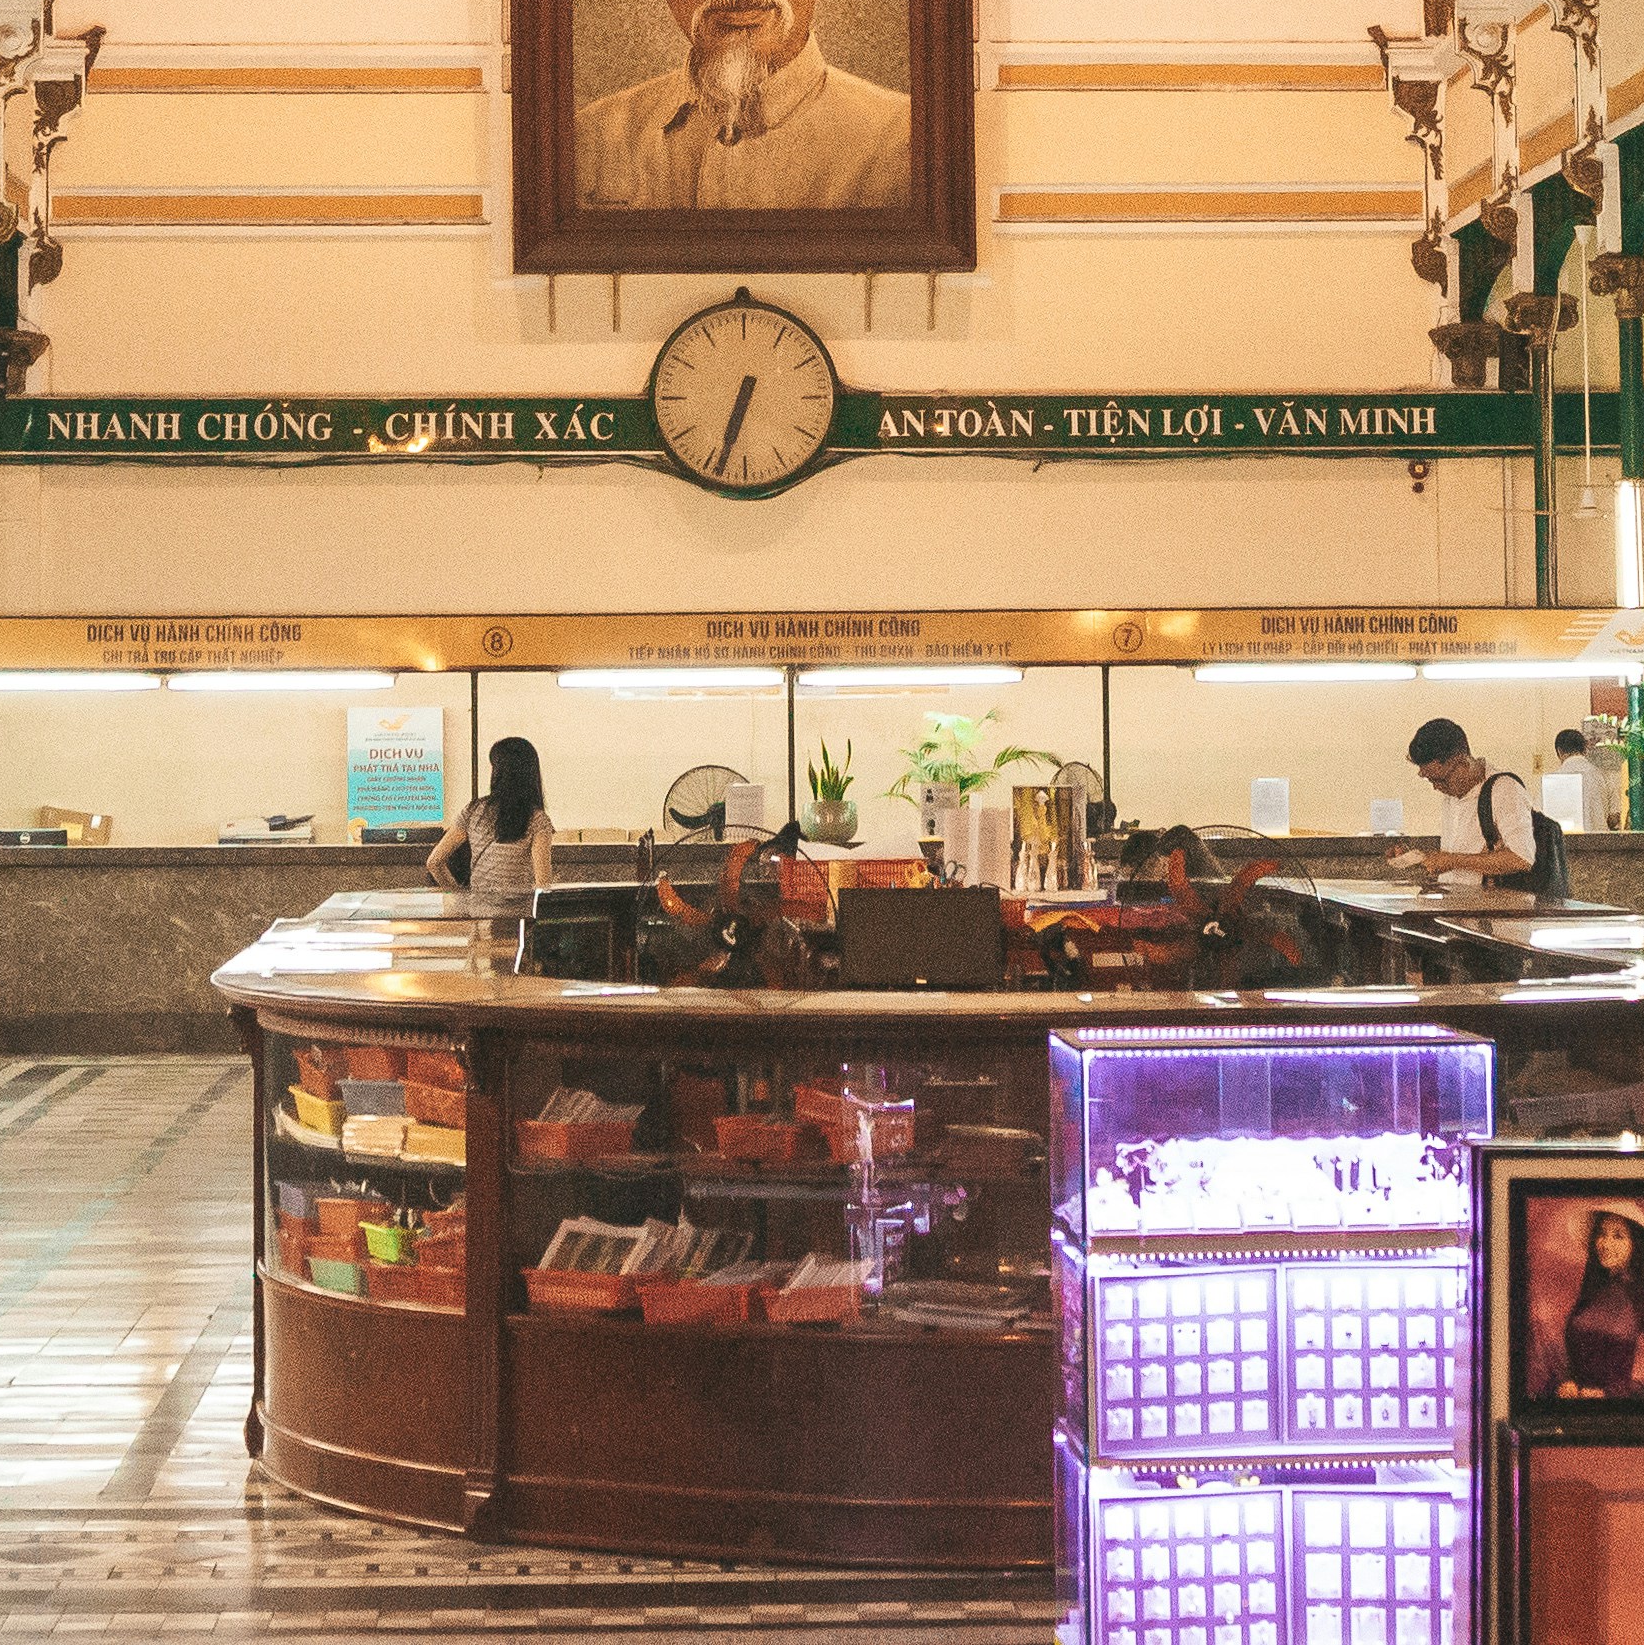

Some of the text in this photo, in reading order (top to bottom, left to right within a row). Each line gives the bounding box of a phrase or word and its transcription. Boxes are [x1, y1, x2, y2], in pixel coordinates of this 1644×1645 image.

[48, 411, 181, 441] NHANH
[198, 403, 333, 441] CHÓNG
[386, 404, 514, 441] CHÍNH
[535, 403, 615, 440] XÁC
[877, 409, 927, 438] AN
[934, 400, 1034, 438] TOÀN
[1064, 400, 1151, 444] TIỆN
[1163, 404, 1223, 444] LỢI
[1254, 399, 1328, 437] VĂN
[1340, 408, 1436, 437] MINH
[156, 623, 200, 642] HÀNH
[205, 623, 254, 642] CHÍNH
[260, 621, 302, 642] CÔNG
[707, 616, 921, 641] DỊCH VỤ HÀNH CHÍNH CÔNG
[1262, 612, 1458, 637] DỊCH VỤ HÀNH CHÍNH CÔNG
[369, 748, 402, 762] DỊCH
